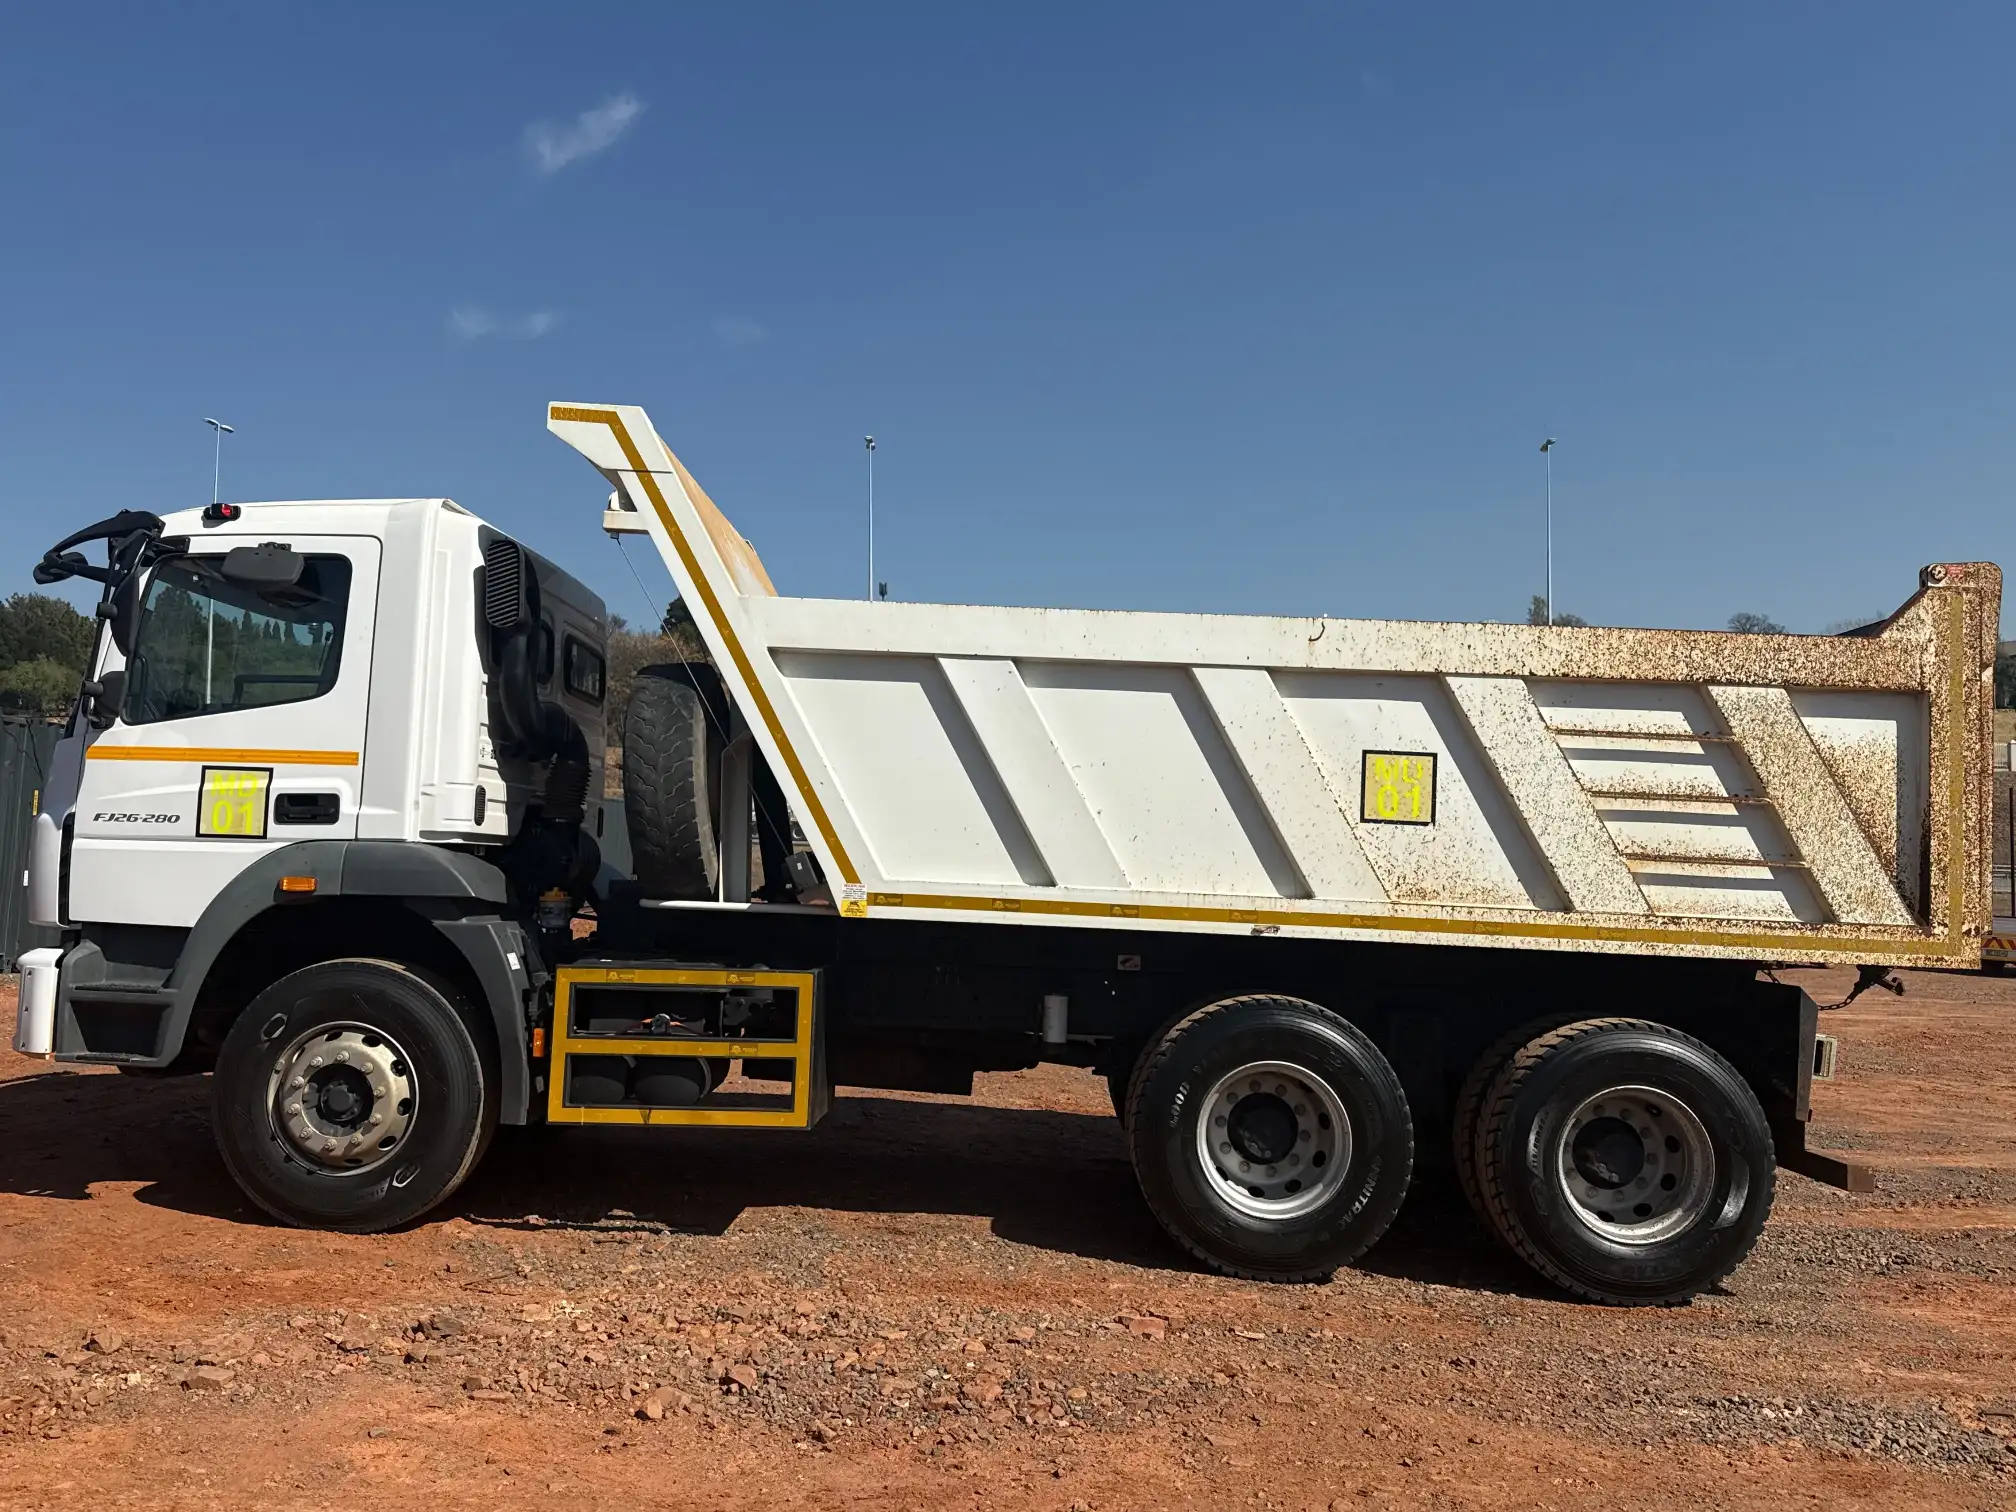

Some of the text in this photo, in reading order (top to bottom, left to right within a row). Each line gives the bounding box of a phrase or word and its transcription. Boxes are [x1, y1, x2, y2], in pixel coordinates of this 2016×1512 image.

[1375, 758, 1423, 783] MD
[211, 773, 258, 798] MD
[1377, 785, 1420, 818] 01
[92, 813, 181, 824] FJ26-280
[211, 800, 254, 834] 01
